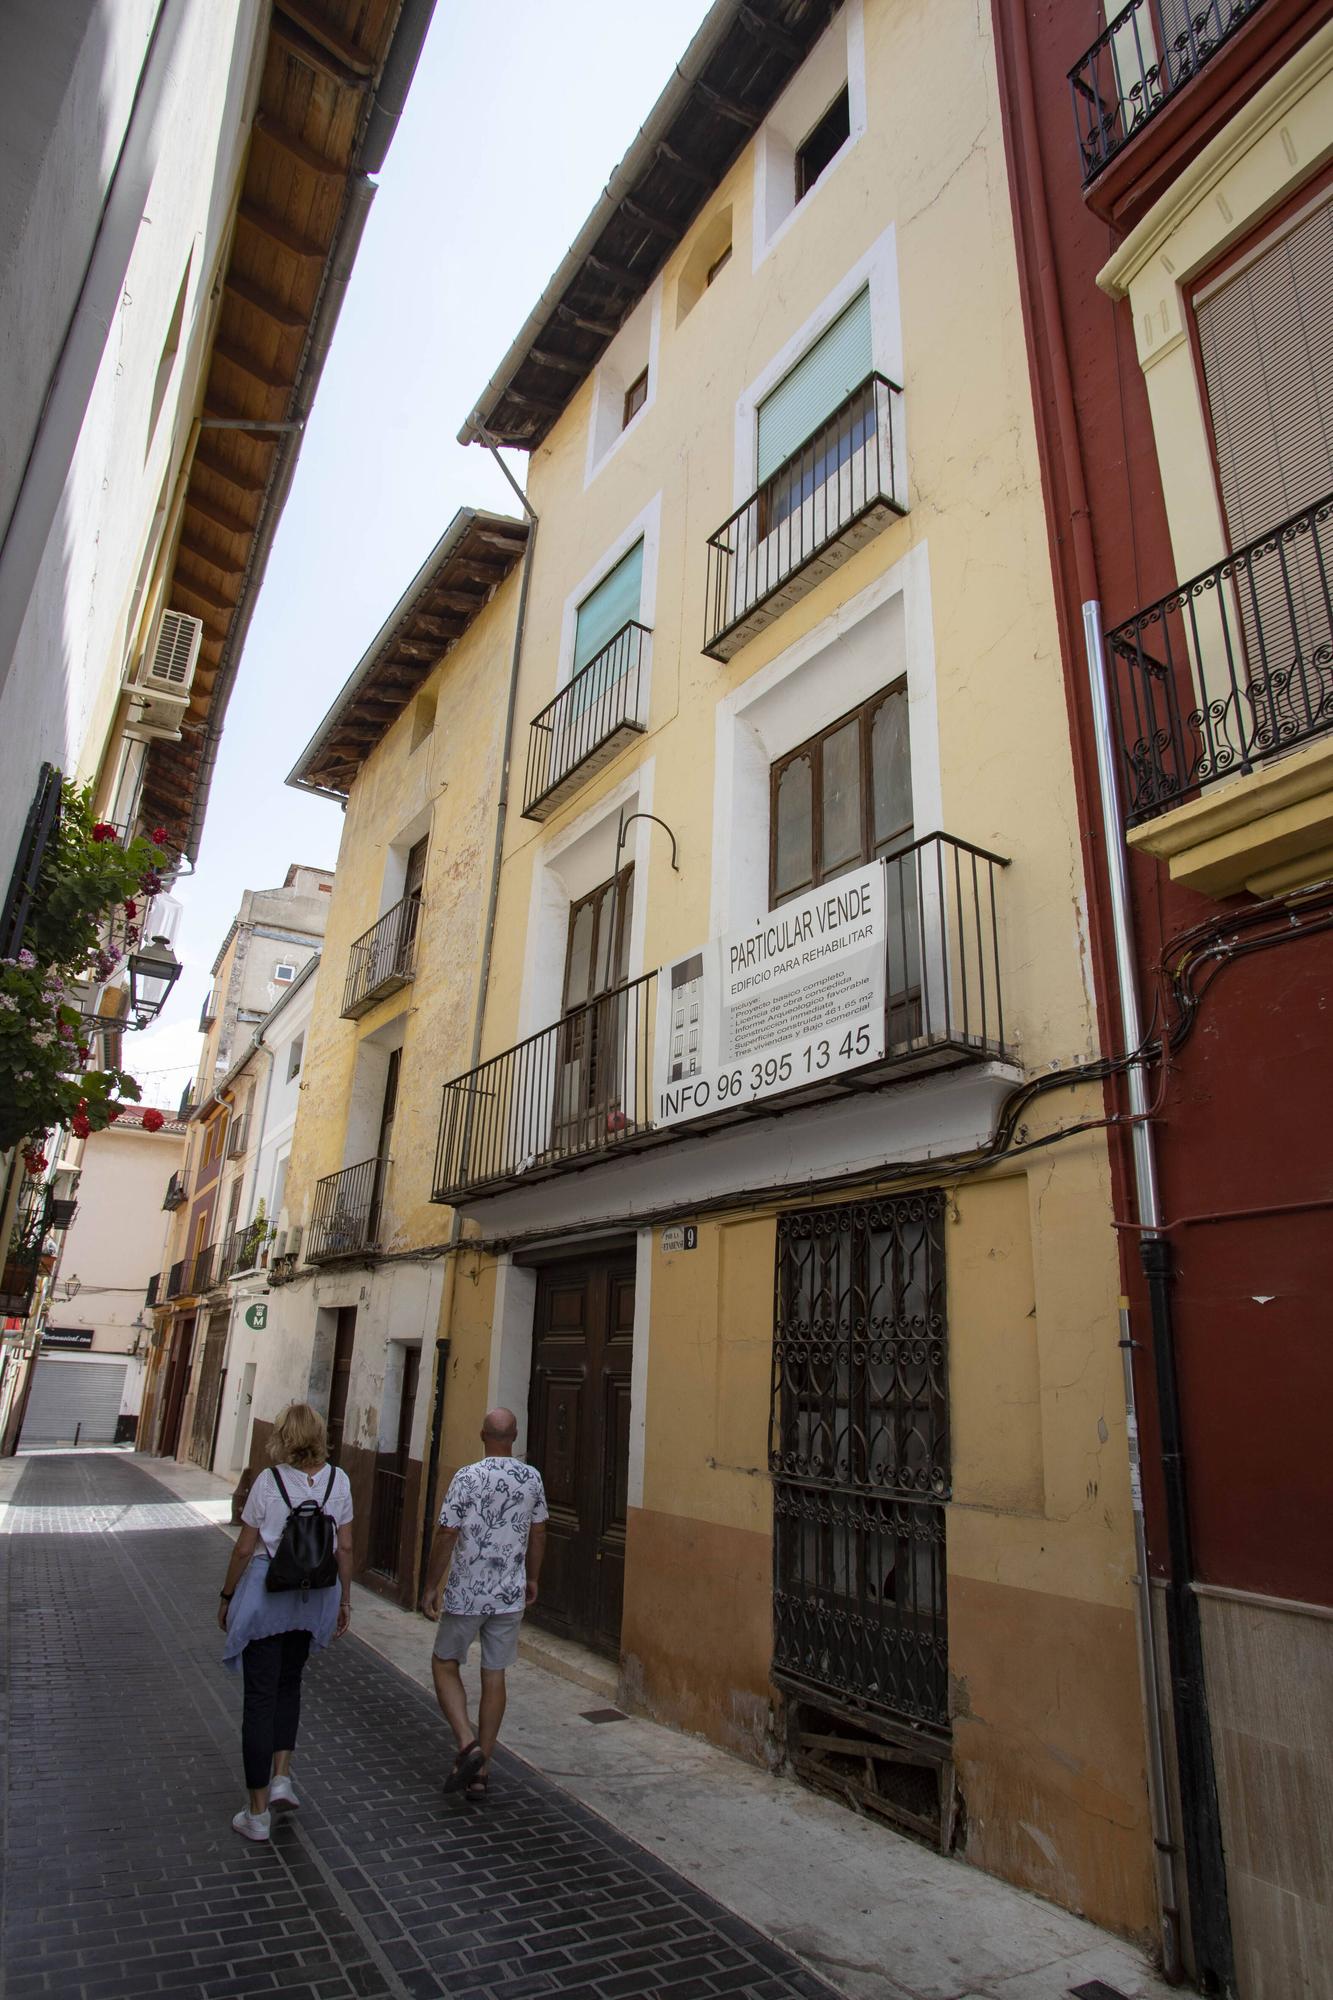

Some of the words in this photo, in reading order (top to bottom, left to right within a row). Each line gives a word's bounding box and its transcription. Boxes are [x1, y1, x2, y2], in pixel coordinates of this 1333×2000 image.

[730, 910, 814, 974] PARTICULAR
[816, 882, 871, 933] VENDE
[731, 969, 771, 995] EDIFICIO
[773, 957, 800, 977] PARA
[802, 924, 873, 964] REHABILITAR
[734, 1031, 775, 1050] Superficie
[776, 1013, 822, 1034] construida
[824, 1000, 857, 1017] 461.65
[859, 991, 874, 1003] m2
[735, 1001, 770, 1018] Proyecto
[803, 971, 845, 992] completo
[735, 1008, 768, 1026] Licencia
[770, 1004, 780, 1013] de
[783, 996, 802, 1008] obra
[805, 976, 852, 999] concedida
[735, 1019, 765, 1034] Informe
[826, 977, 870, 999] favorable
[790, 1001, 834, 1021] inmediata
[734, 1047, 752, 1059] Tres
[754, 1033, 793, 1052] viviendas
[795, 1030, 801, 1039] y
[803, 1021, 823, 1034] Bajo
[825, 1002, 870, 1025] comercial
[660, 1081, 710, 1119] INFO
[717, 1069, 742, 1100] 96
[750, 1052, 792, 1091] 395
[802, 1040, 830, 1073] 13
[839, 1024, 870, 1059] 45
[687, 1229, 694, 1248] 9
